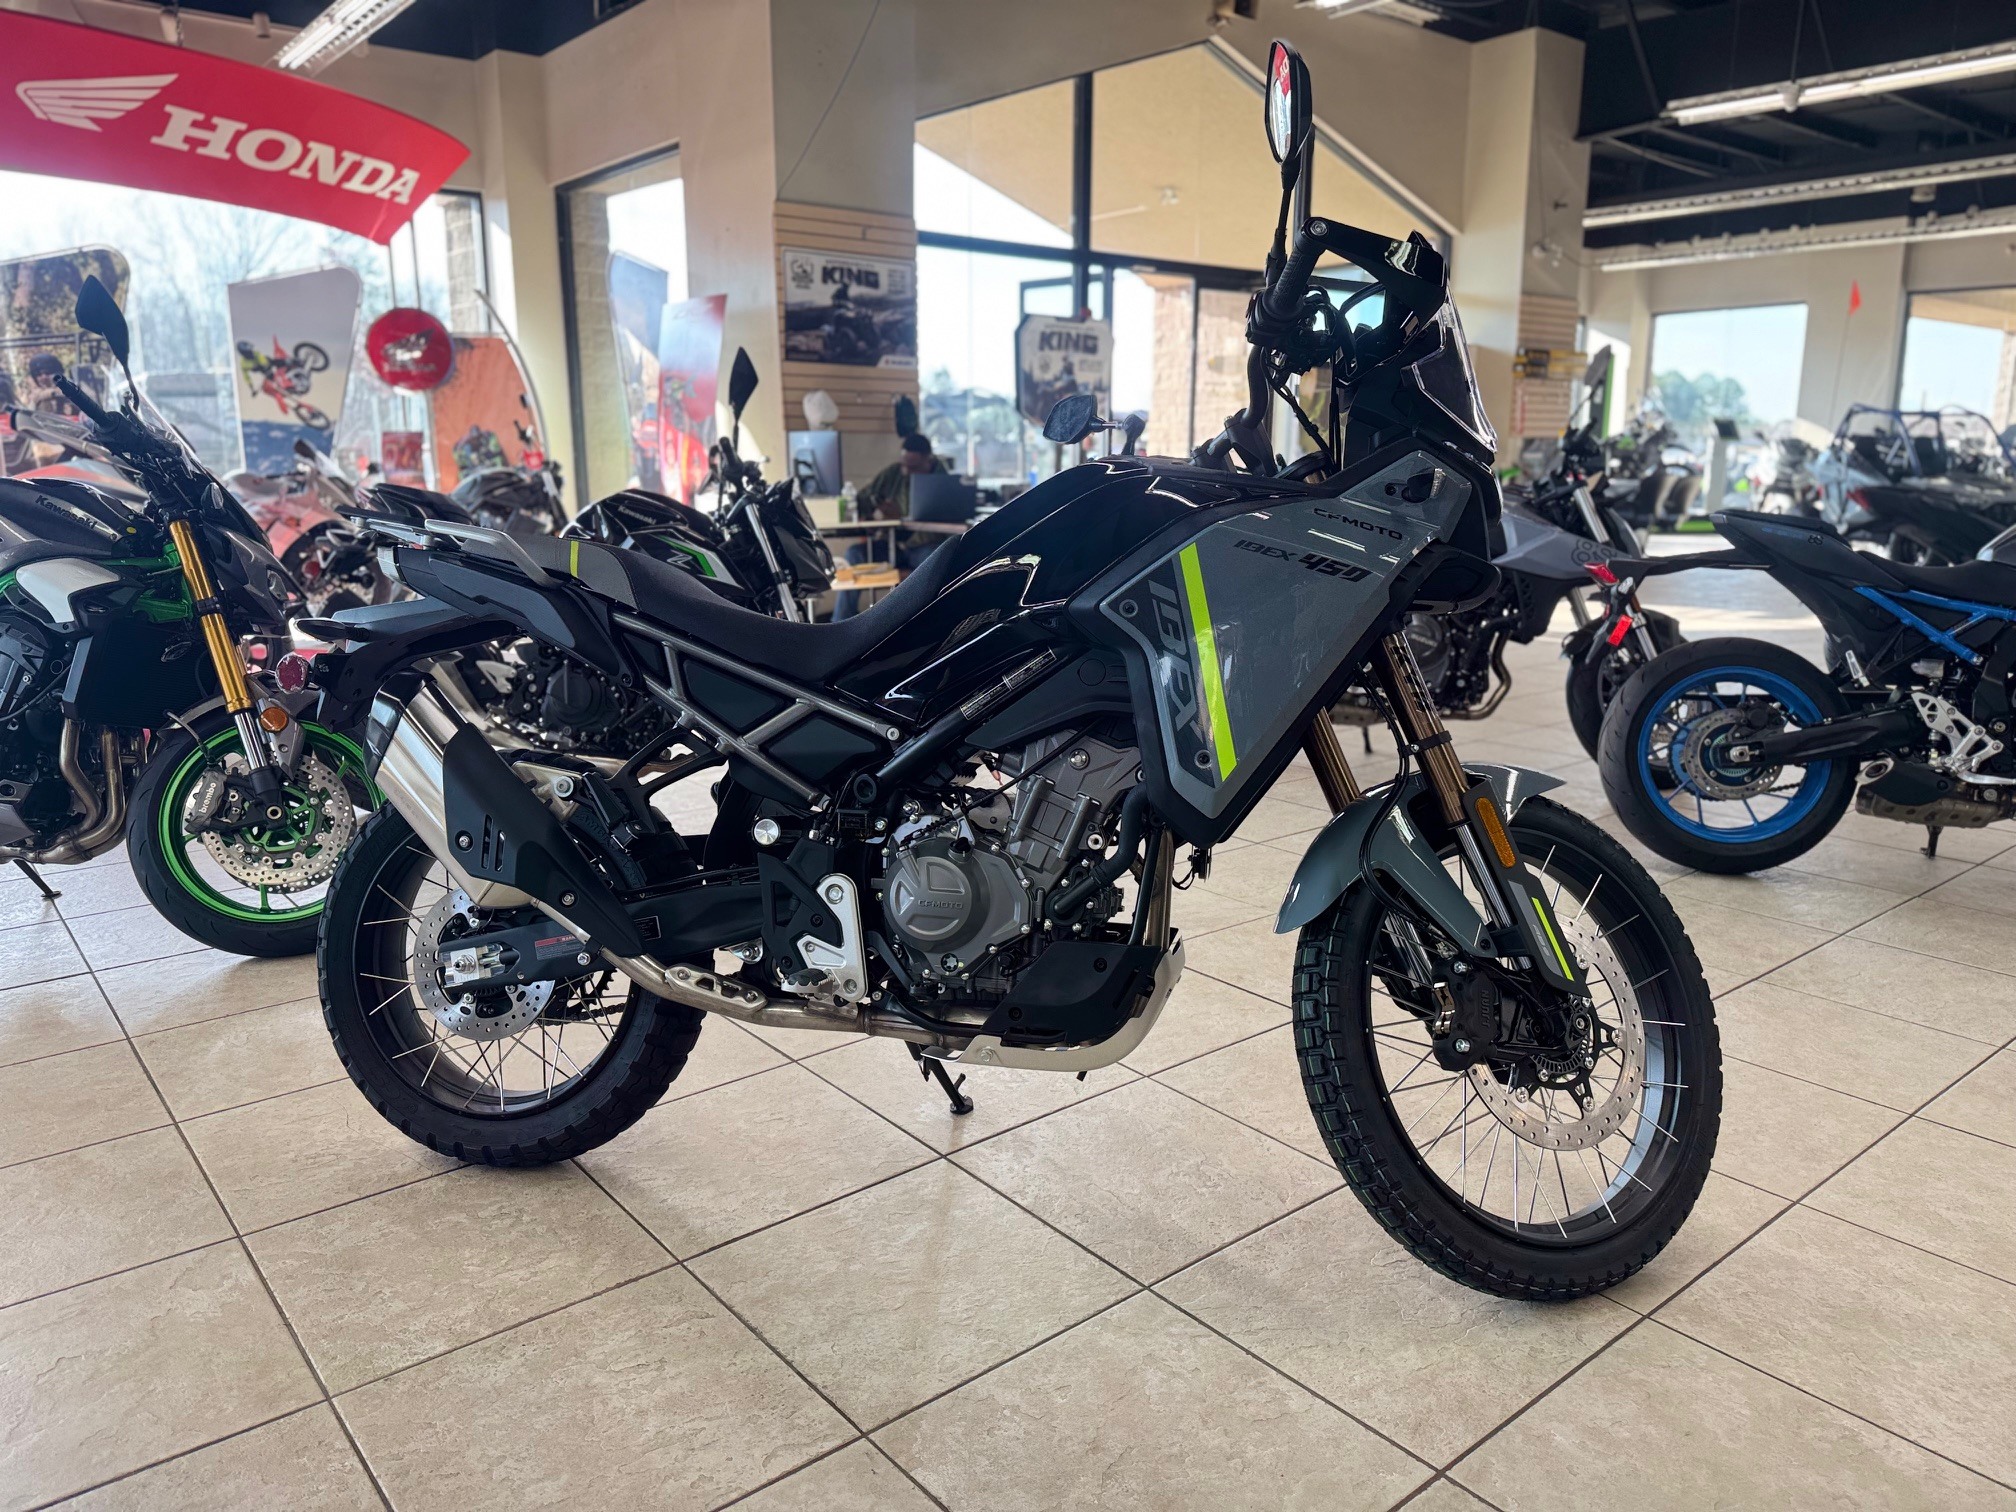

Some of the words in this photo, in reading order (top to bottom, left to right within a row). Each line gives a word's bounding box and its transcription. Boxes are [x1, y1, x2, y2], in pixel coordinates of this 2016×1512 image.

[149, 103, 420, 205] HONDA
[821, 265, 880, 289] KING
[1039, 330, 1098, 355] KING
[35, 494, 98, 530] Kawasaki
[617, 504, 657, 525] Kawasaki
[1313, 507, 1403, 541] CFMOTO
[1234, 539, 1298, 562] IBEX
[1298, 552, 1374, 583] 450
[198, 782, 217, 814] brembo
[917, 899, 964, 909] CFMOTO
